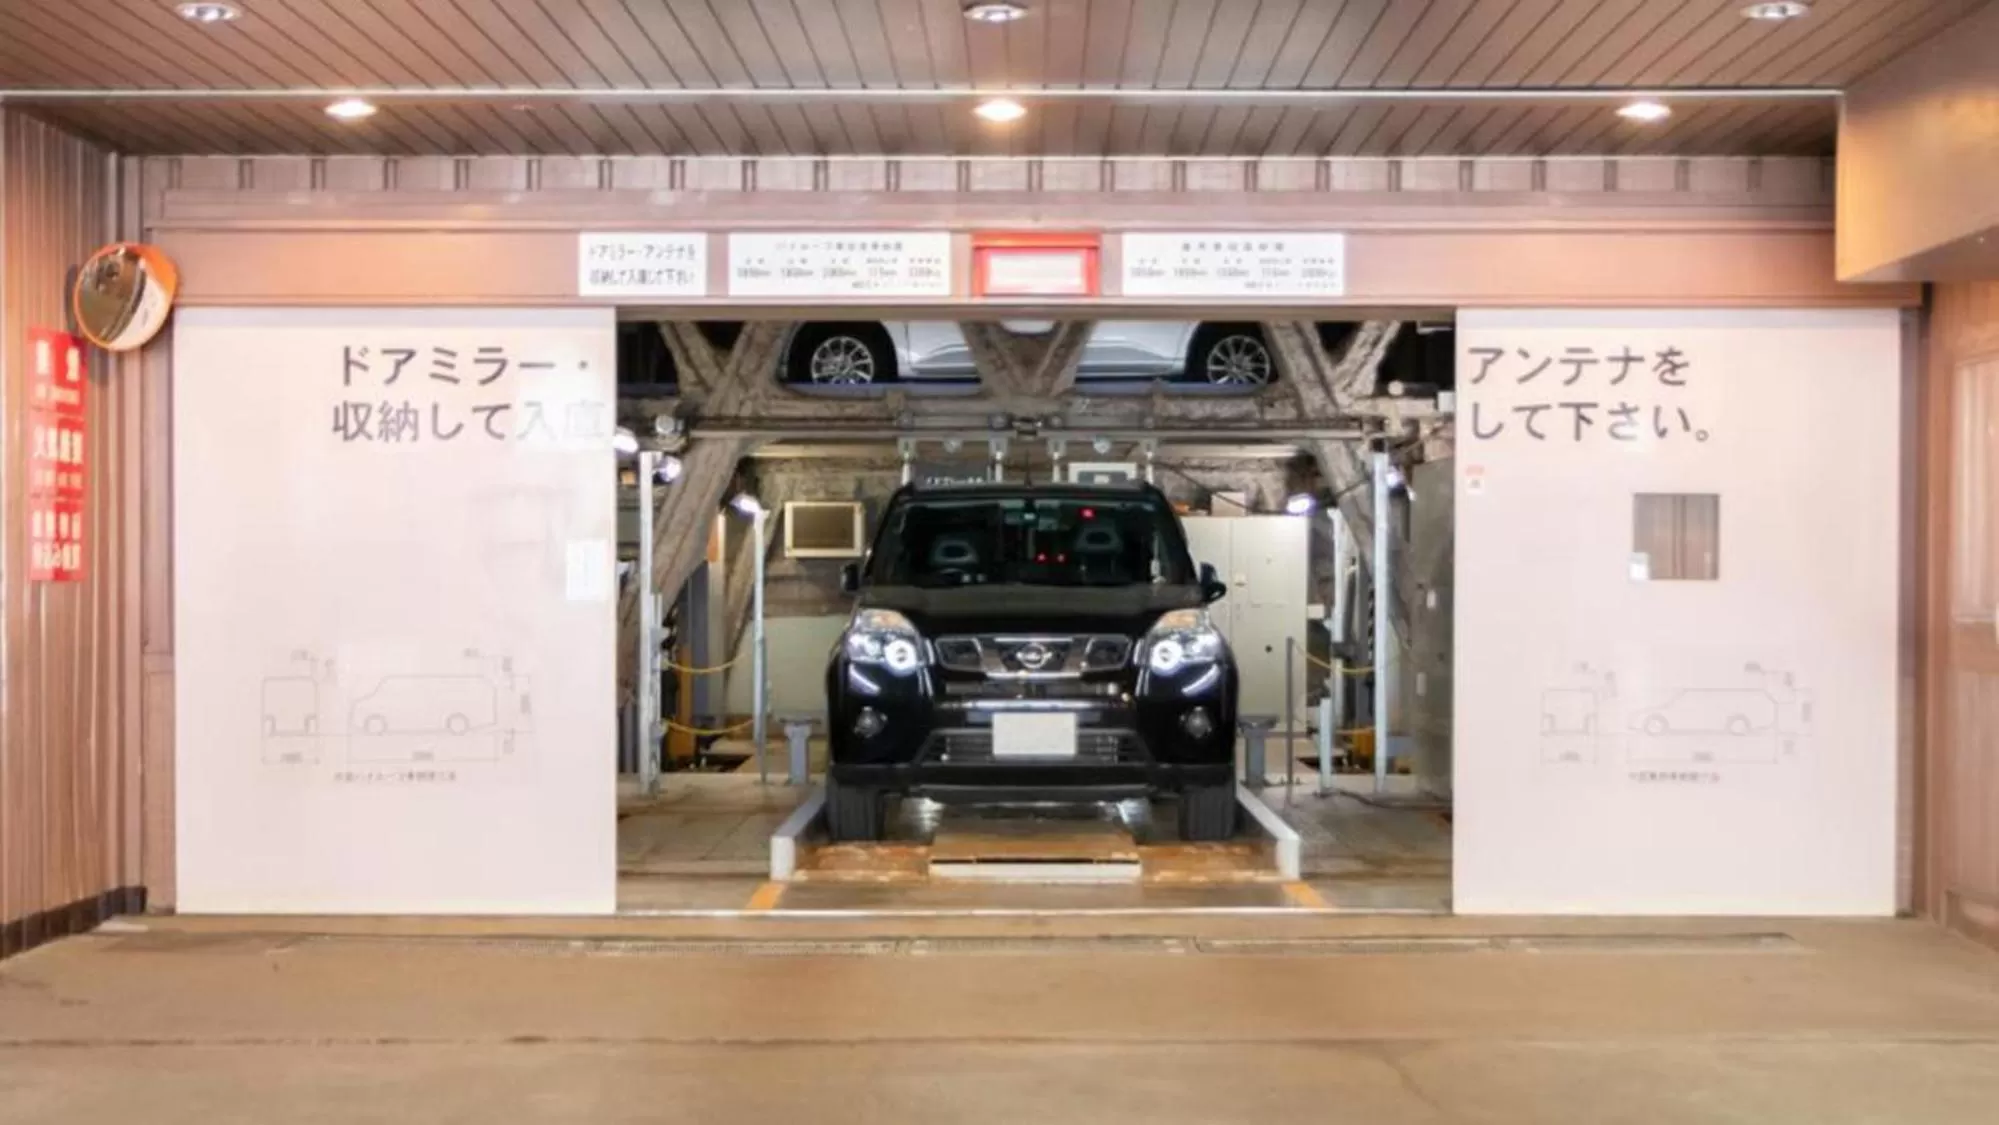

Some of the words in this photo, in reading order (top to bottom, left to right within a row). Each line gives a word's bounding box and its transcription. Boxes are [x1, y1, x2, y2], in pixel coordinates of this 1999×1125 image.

[1467, 346, 1691, 387] アンテナを
[1471, 402, 1711, 443] して下さい。
